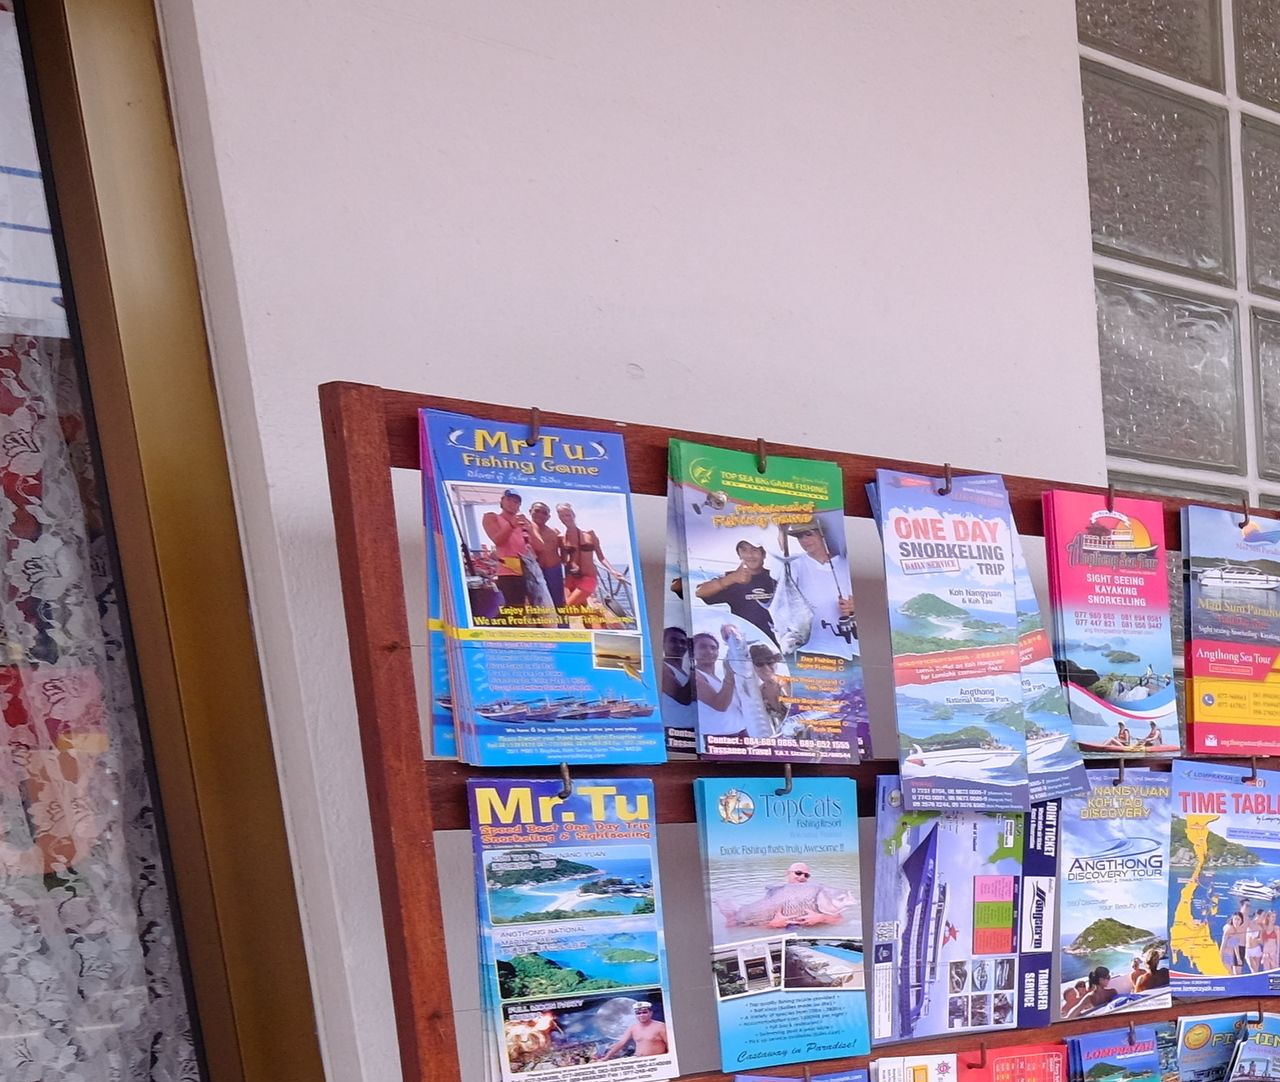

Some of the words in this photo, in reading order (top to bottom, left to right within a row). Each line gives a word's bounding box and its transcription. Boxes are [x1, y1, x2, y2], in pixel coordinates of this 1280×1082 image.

[474, 429, 584, 461] Mr.Tu
[462, 453, 534, 475] Fishing
[541, 460, 599, 476] Game
[720, 471, 737, 479] TOP
[795, 483, 829, 494] FISHING
[894, 516, 946, 541] ONE
[952, 520, 999, 543] DAY
[900, 542, 1005, 561] SNORKELING
[905, 561, 925, 571] DAILY
[926, 559, 956, 569] SERVICE
[976, 562, 1006, 576] TRIP
[1086, 573, 1111, 584] SIGHT
[1114, 575, 1145, 585] SEEING
[949, 589, 964, 597] Koh
[965, 589, 1002, 599] Nangyuan
[1095, 585, 1138, 596] KAYAKING
[1088, 595, 1147, 607] SNORKELLING
[1196, 648, 1239, 664] Angthong
[1240, 652, 1253, 663] Sea
[1254, 653, 1271, 664] Tour
[946, 696, 972, 704] National
[996, 696, 1009, 704] Park
[960, 688, 994, 698] Angthong
[1094, 785, 1170, 798] NANGYUAN
[475, 786, 649, 825] Mr.Tu
[760, 794, 842, 824] TopCats
[1088, 798, 1112, 808] KOH
[1119, 797, 1143, 808] TAO
[1178, 791, 1227, 814] TIME
[1045, 801, 1058, 826] JOINT
[1080, 808, 1151, 820] DISCOVERY
[479, 824, 522, 836] Speed
[527, 823, 559, 833] Boat
[565, 823, 590, 833] One
[595, 822, 620, 832] Day
[627, 821, 651, 831] Trip
[797, 819, 823, 829] Fishing
[823, 819, 842, 828] Resort
[482, 832, 555, 844] Snorkeling
[560, 832, 570, 841] &
[576, 831, 651, 842] Sightseeing
[1043, 826, 1057, 857] TICKET
[720, 846, 740, 856] Exotic
[742, 845, 766, 856] Fishing
[803, 844, 839, 853] Awesome
[1069, 855, 1163, 872] ANGTHONG
[1068, 869, 1129, 881] DISCOVERY
[1131, 868, 1162, 877] TOUR
[500, 928, 547, 938] ANGTHONG
[548, 926, 586, 934] NATIONAL
[1023, 972, 1036, 1008] SERVICE
[1038, 968, 1050, 1011] TRANSFER
[737, 1048, 788, 1063] Castaway
[806, 1038, 857, 1053] Paradise!
